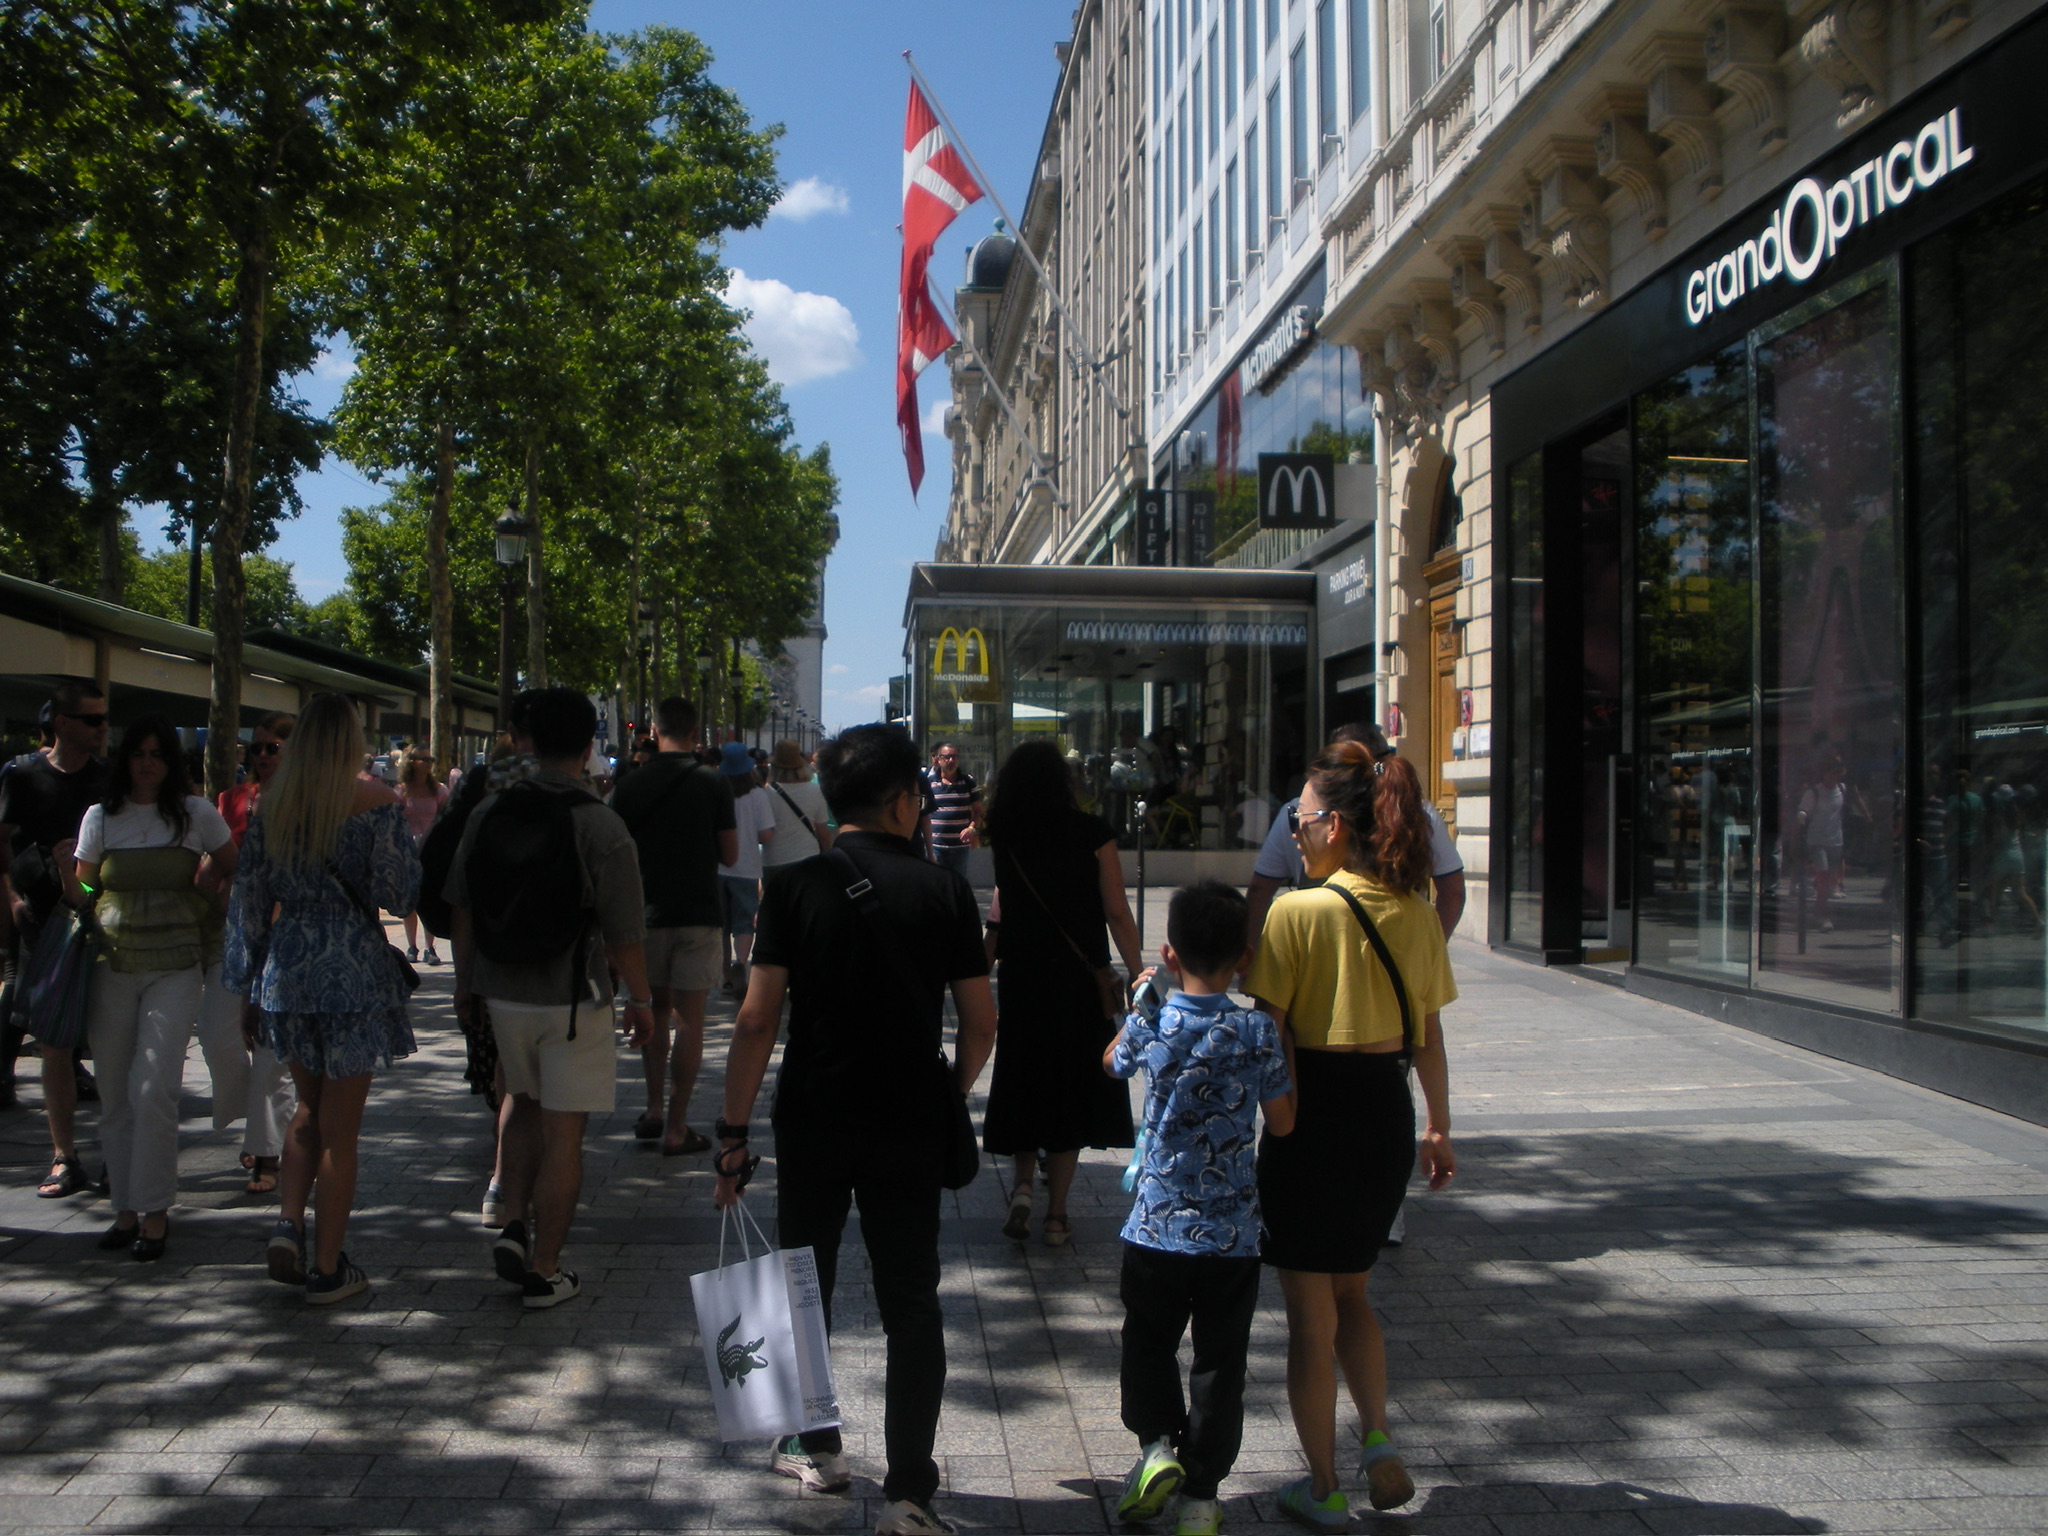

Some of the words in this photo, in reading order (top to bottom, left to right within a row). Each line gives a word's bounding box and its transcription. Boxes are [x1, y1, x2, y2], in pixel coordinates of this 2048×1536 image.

[1241, 305, 1307, 396] McDonald's
[1330, 566, 1349, 594] PARKING
[933, 673, 990, 683] McDonald's
[1975, 726, 2020, 739] grandoptical.com
